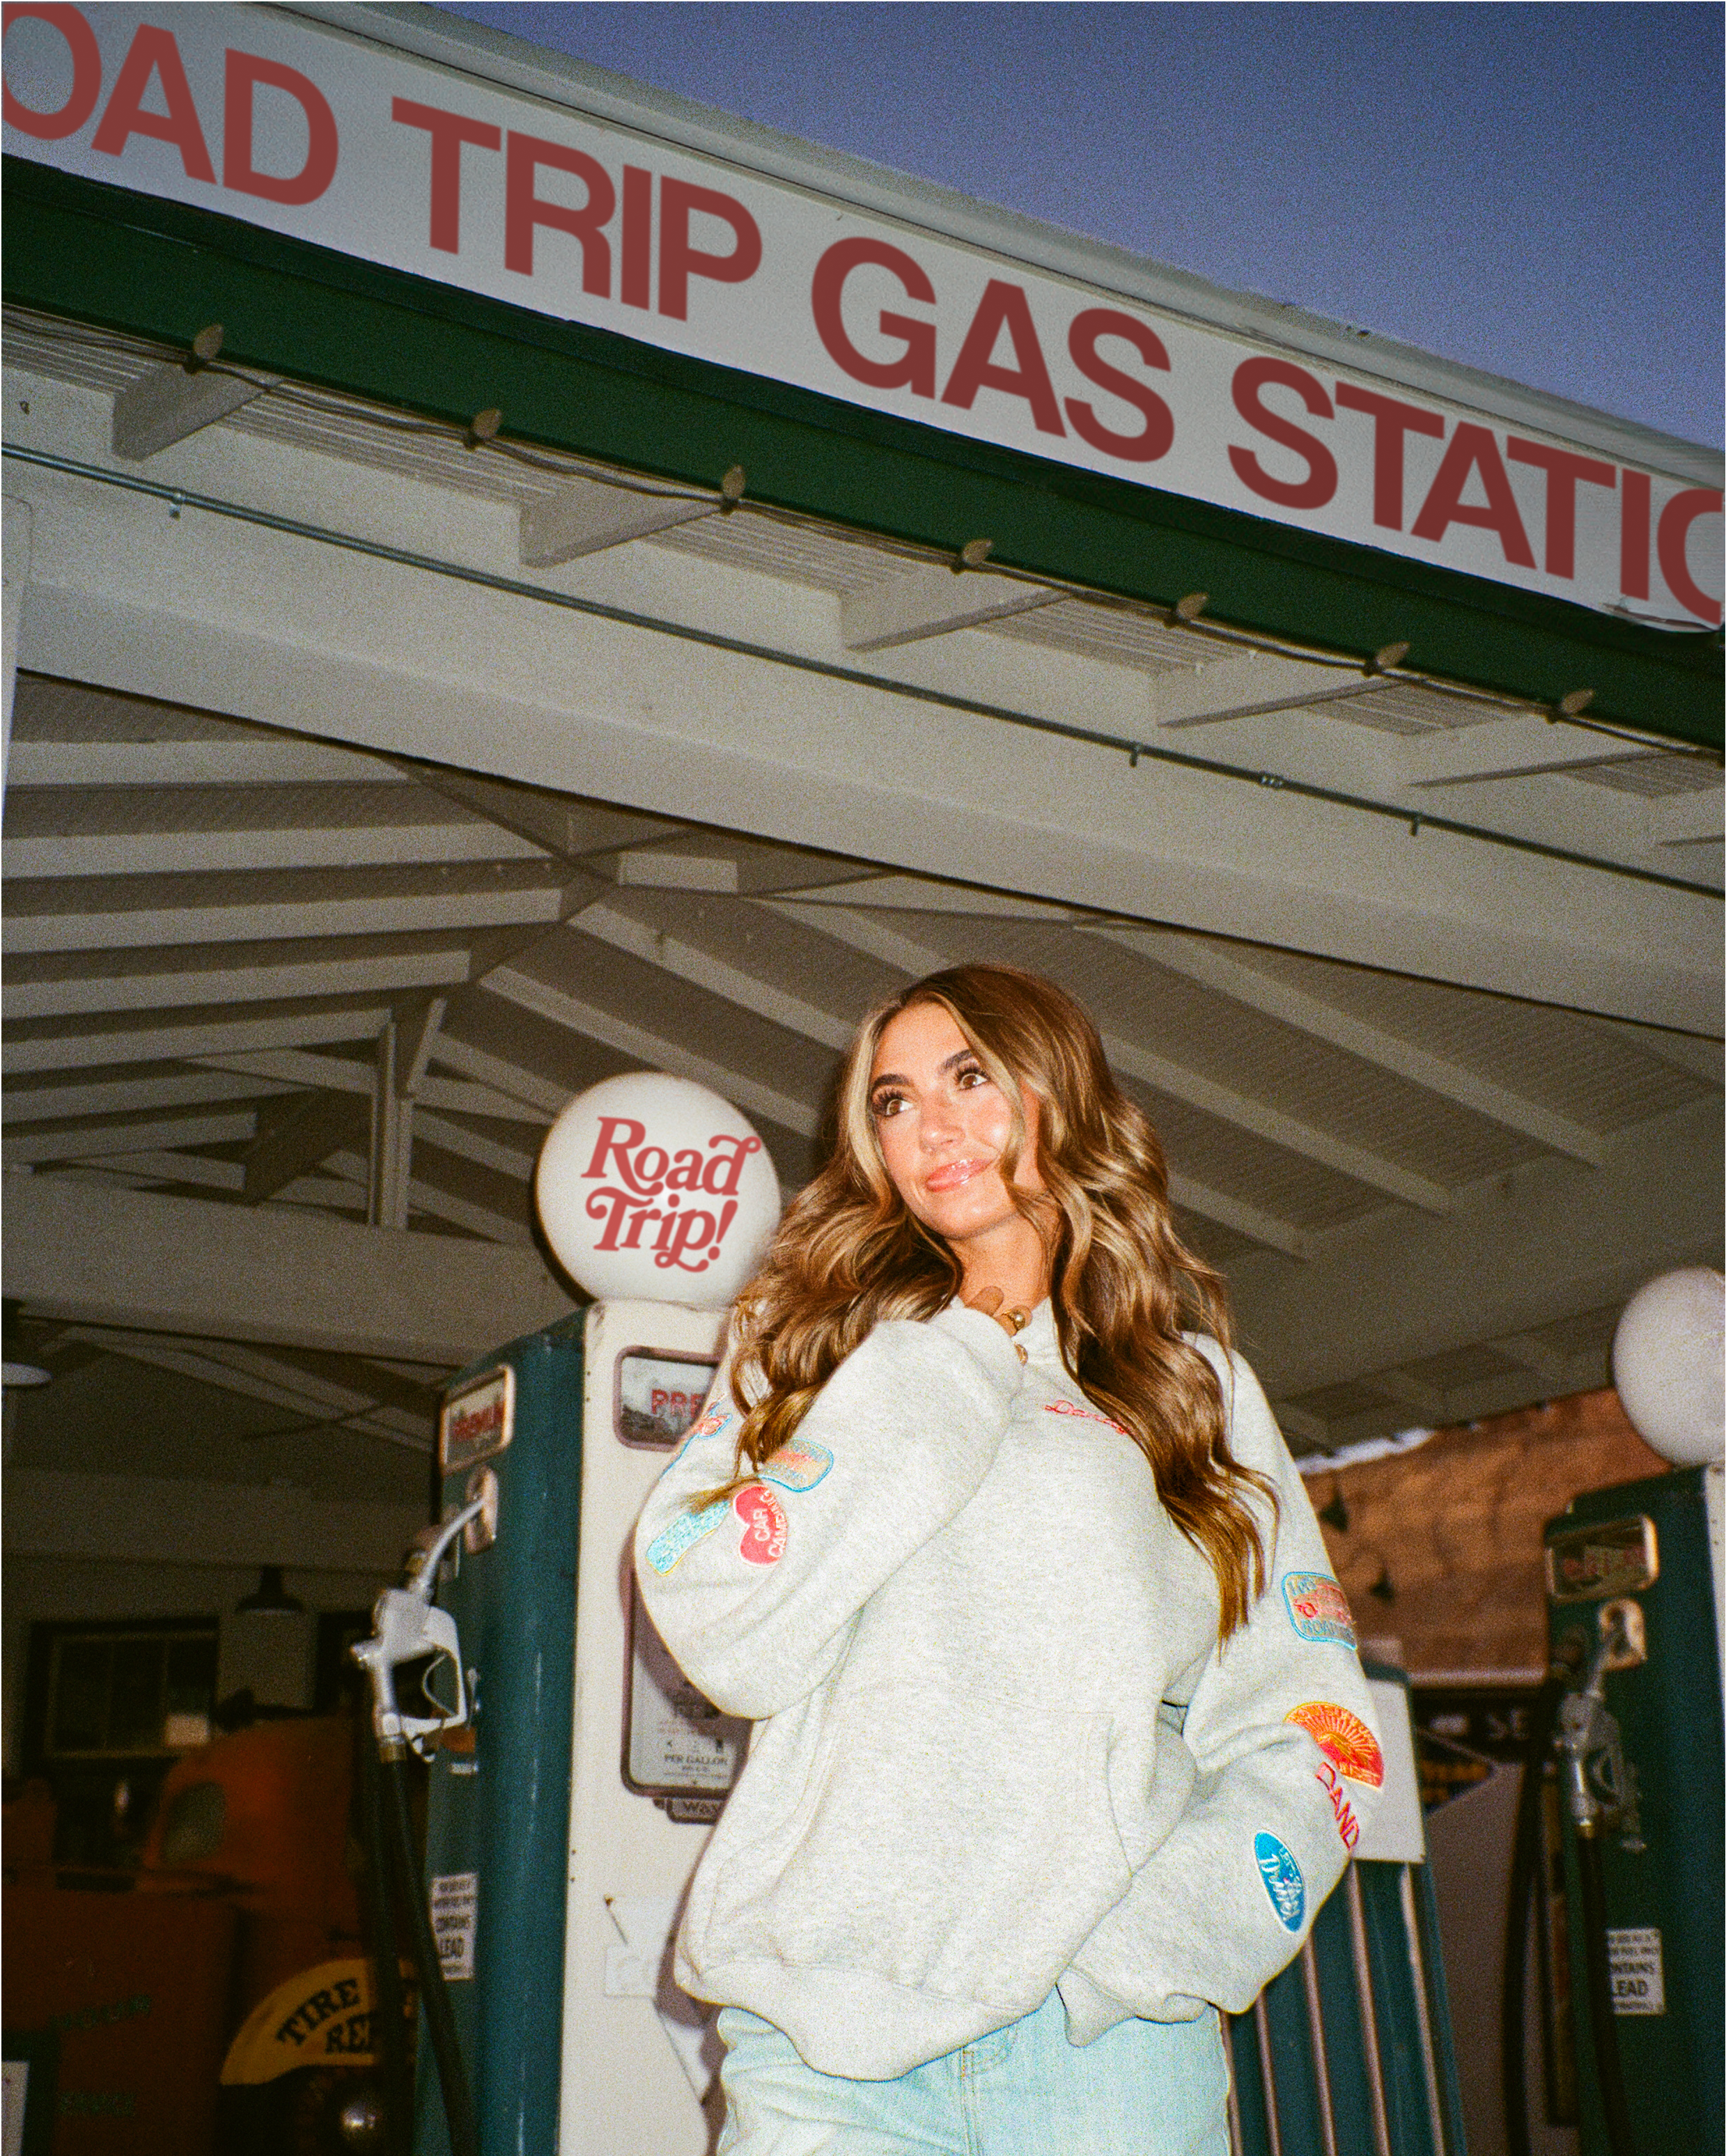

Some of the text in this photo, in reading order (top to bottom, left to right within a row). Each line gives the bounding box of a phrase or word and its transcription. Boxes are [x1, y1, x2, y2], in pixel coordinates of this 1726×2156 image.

[1, 1, 339, 205] OAD
[392, 97, 762, 321] TRIP
[811, 237, 1174, 462] GAS
[580, 1116, 762, 1198] Road
[586, 1186, 738, 1273] Trip!
[754, 1508, 770, 1542] CAR
[276, 1978, 360, 2047] TIRE
